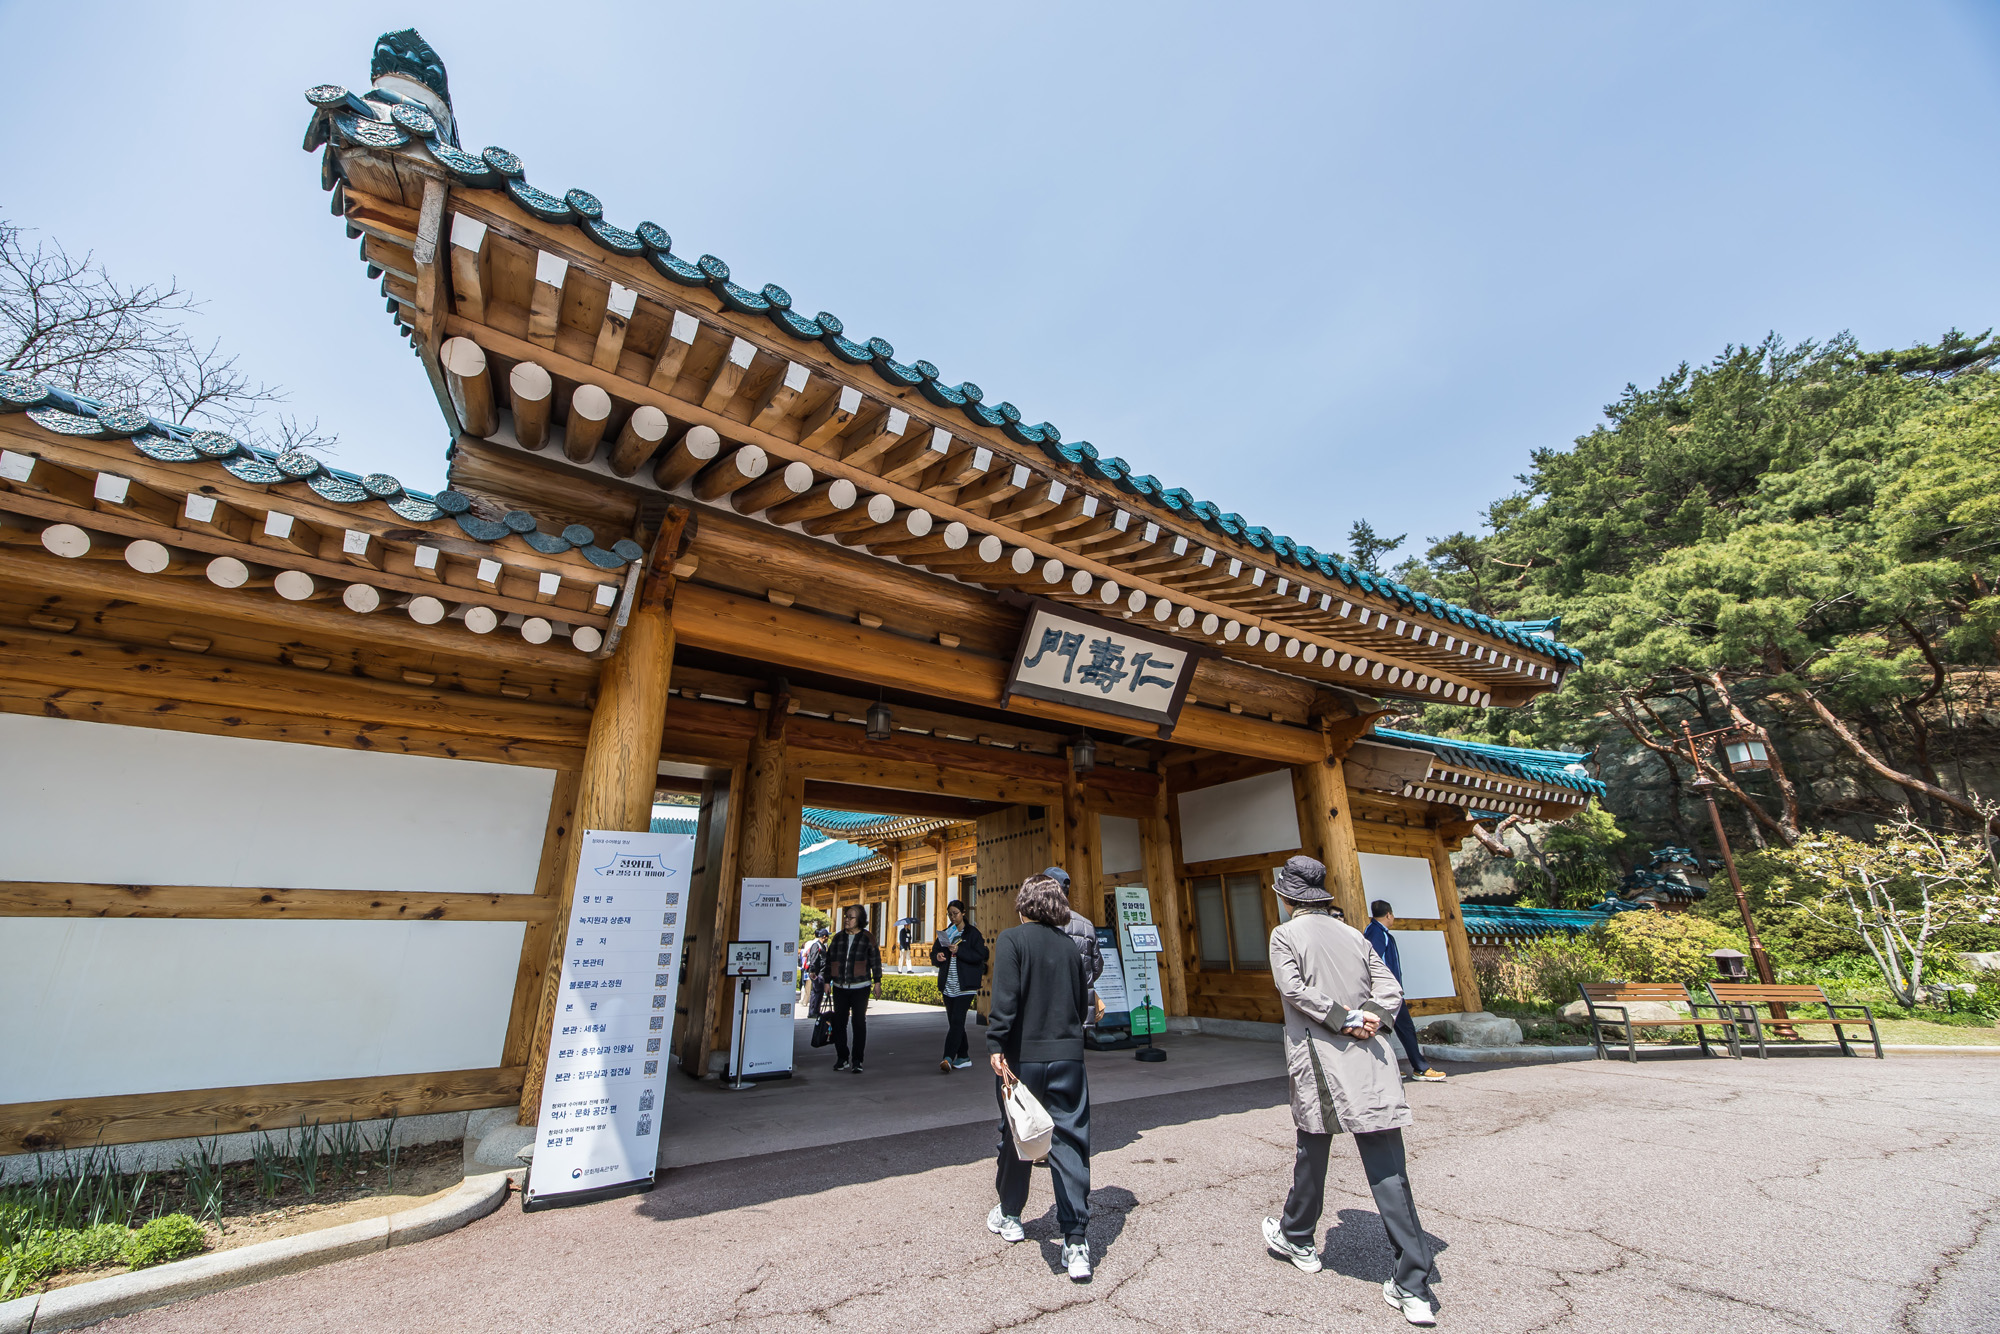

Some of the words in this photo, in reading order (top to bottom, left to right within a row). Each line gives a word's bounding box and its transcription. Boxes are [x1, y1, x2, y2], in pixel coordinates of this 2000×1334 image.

[620, 859, 654, 869] 청와대,
[579, 916, 608, 925] 녹지원과
[610, 916, 632, 925] 상춘재
[1122, 910, 1146, 922] 특별한
[572, 959, 580, 967] 구
[582, 958, 604, 967] 본관터
[568, 980, 599, 990] 불로문과
[600, 979, 622, 988] 소정원
[562, 1026, 578, 1035] 본관
[584, 1024, 606, 1033] 세종실
[558, 1049, 574, 1058] 본관
[580, 1046, 611, 1056] 충무실과
[612, 1044, 634, 1054] 인왕실
[554, 1072, 571, 1082] 본관
[578, 1070, 608, 1080] 집무실과
[610, 1066, 632, 1077] 접견실
[551, 1110, 567, 1120] 역사
[575, 1108, 590, 1118] 문화
[592, 1106, 608, 1116] 공간
[610, 1104, 618, 1114] 편
[546, 1137, 563, 1148] 본관
[566, 1136, 574, 1146] 편
